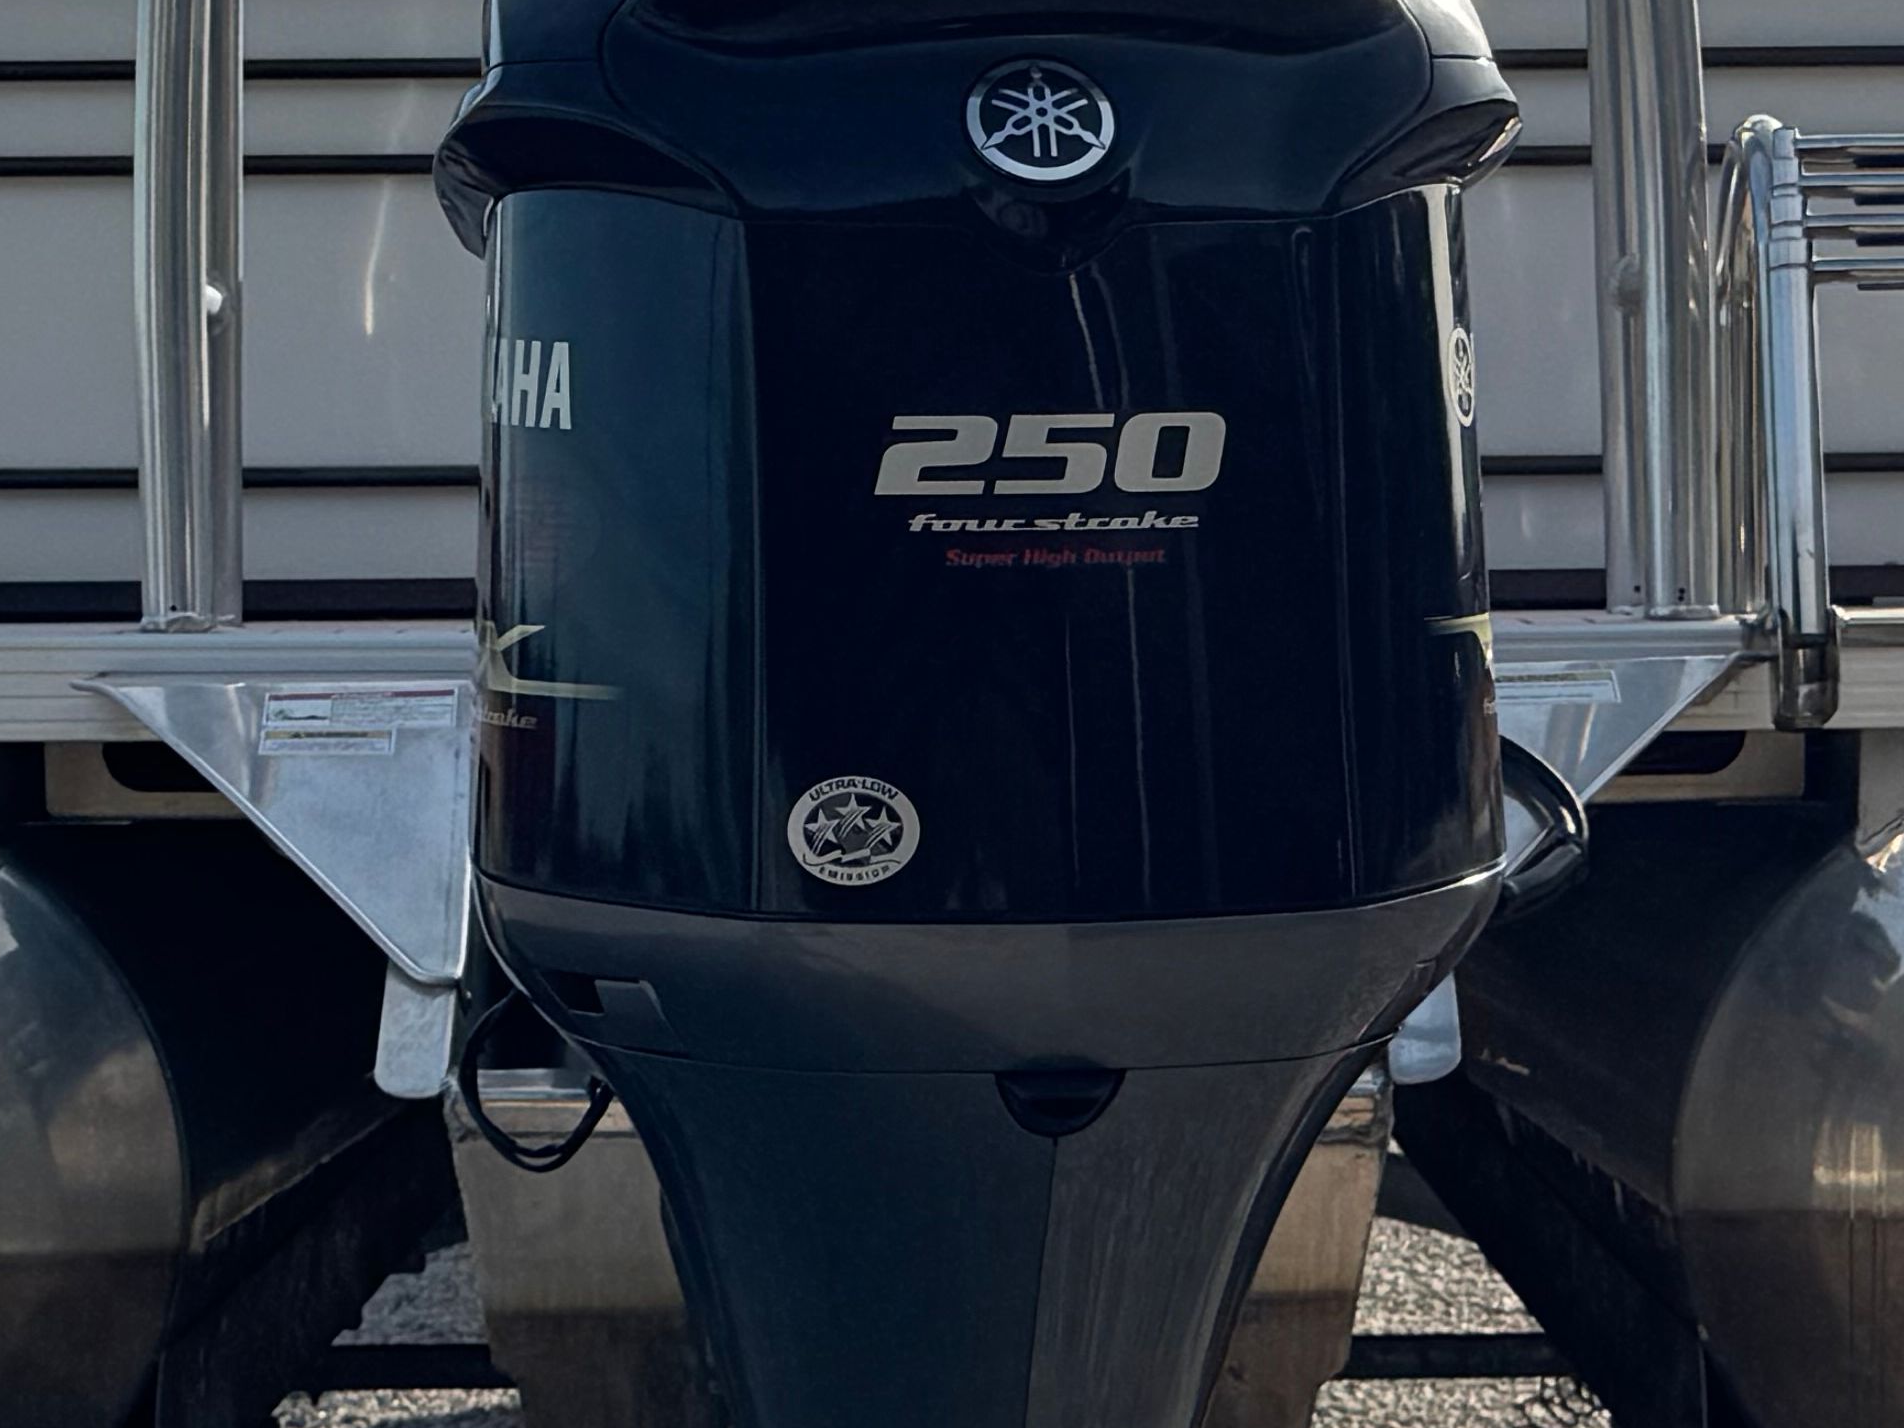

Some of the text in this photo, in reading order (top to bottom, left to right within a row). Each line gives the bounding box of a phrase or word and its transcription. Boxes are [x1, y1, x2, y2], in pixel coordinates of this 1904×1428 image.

[873, 412, 1227, 496] 250
[945, 547, 1018, 568] Super
[1023, 547, 1077, 568] High
